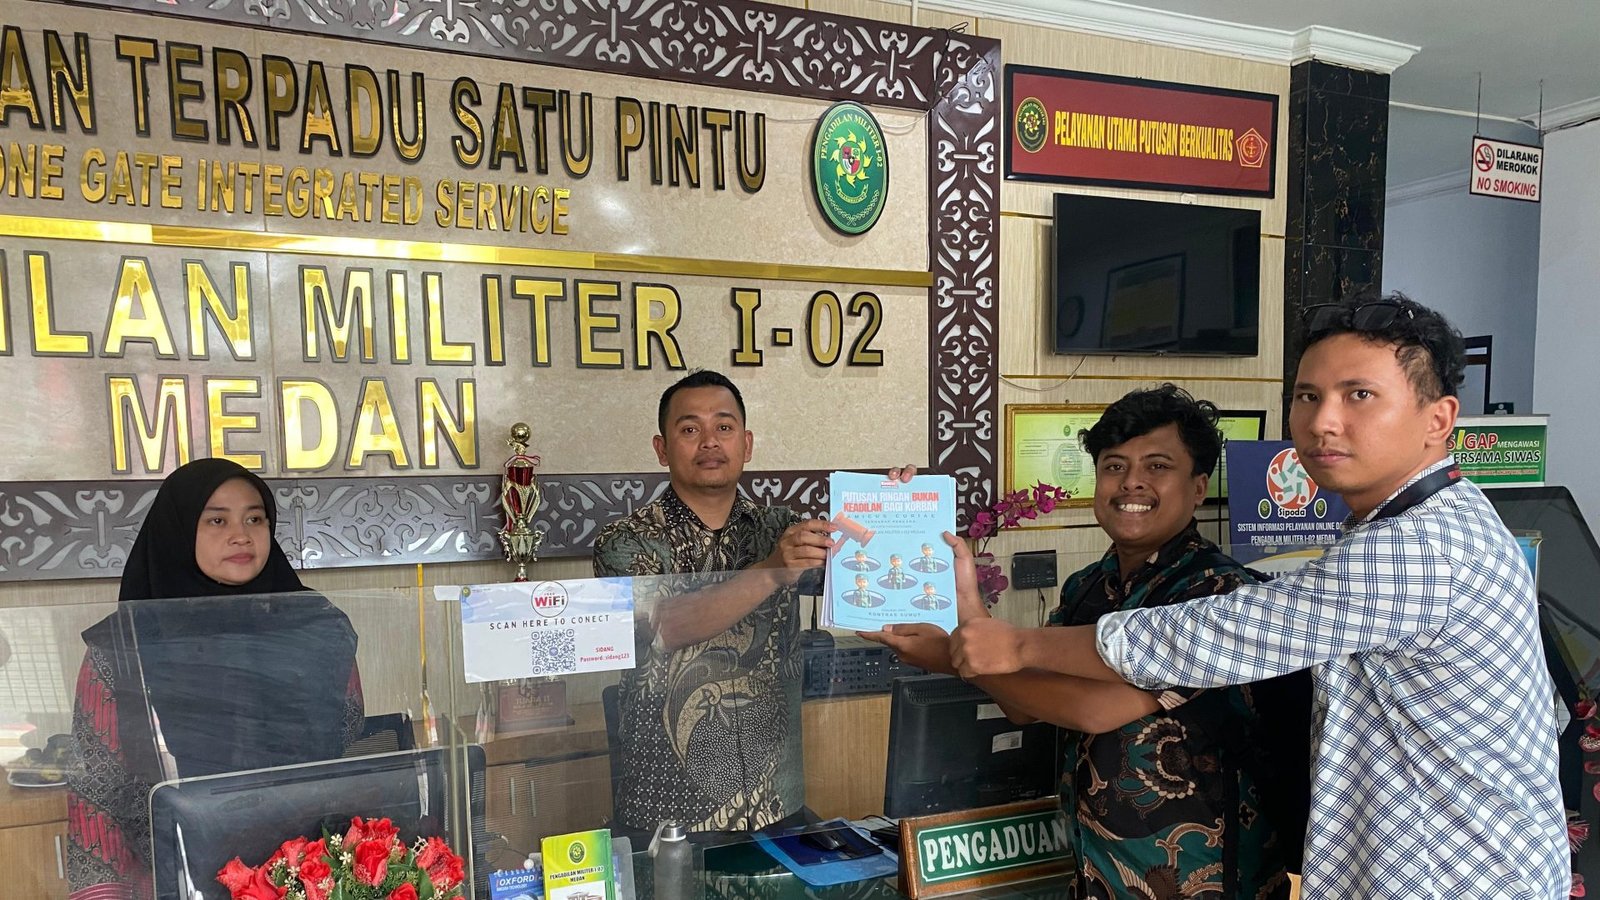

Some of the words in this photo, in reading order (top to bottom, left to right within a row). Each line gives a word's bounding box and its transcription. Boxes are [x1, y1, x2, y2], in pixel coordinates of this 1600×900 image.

[0, 25, 97, 134] AN
[115, 34, 427, 165] TERPADU
[451, 77, 593, 178] SATU
[615, 96, 767, 193] PINTU
[821, 113, 853, 159] PENGADILAN
[854, 114, 880, 147] MILITER
[1055, 111, 1105, 149] PELAYANAN
[1107, 116, 1137, 152] UTAMA
[1139, 119, 1179, 156] PUTUSAN
[1179, 123, 1233, 162] BERKUALITAS
[1496, 148, 1539, 164] DILARANG
[1496, 160, 1538, 175] MEROKOK
[0, 142, 65, 199] NE
[80, 148, 183, 208] GATE
[198, 158, 424, 225] INTEGRATED
[434, 178, 571, 235] SERVICE
[1477, 177, 1491, 191] NO
[1493, 179, 1536, 197] SMOKING
[298, 264, 686, 369] MILITER
[730, 287, 884, 368] I-02
[105, 373, 480, 473] MEDAN
[1497, 440, 1540, 448] MENGAWASI
[1451, 451, 1502, 464] ERSAMA
[1504, 450, 1541, 463] SIWAS
[842, 491, 878, 502] PUTUSAN
[879, 492, 910, 502] RINGAN
[911, 492, 939, 502] BUKAN
[843, 502, 882, 512] KEADILAN
[884, 502, 905, 512] BAGI
[906, 501, 938, 512] KORBAN
[1278, 508, 1307, 519] Sipoda
[1238, 523, 1256, 532] SISTEM
[1257, 522, 1285, 532] INFORMASI
[1285, 522, 1315, 531] PELAYANAN
[1315, 522, 1335, 531] ONLINE
[1251, 535, 1283, 546] PENGADILAN
[1283, 535, 1304, 545] MILITER
[1316, 534, 1336, 545] MEDAN
[534, 595, 566, 608] WiFi
[489, 621, 517, 630] SCAN
[522, 619, 548, 628] HERE
[554, 618, 566, 626] TO
[571, 614, 610, 624] CONECT
[923, 818, 1068, 872] PENGADUAN
[499, 875, 535, 886] OXFORD
